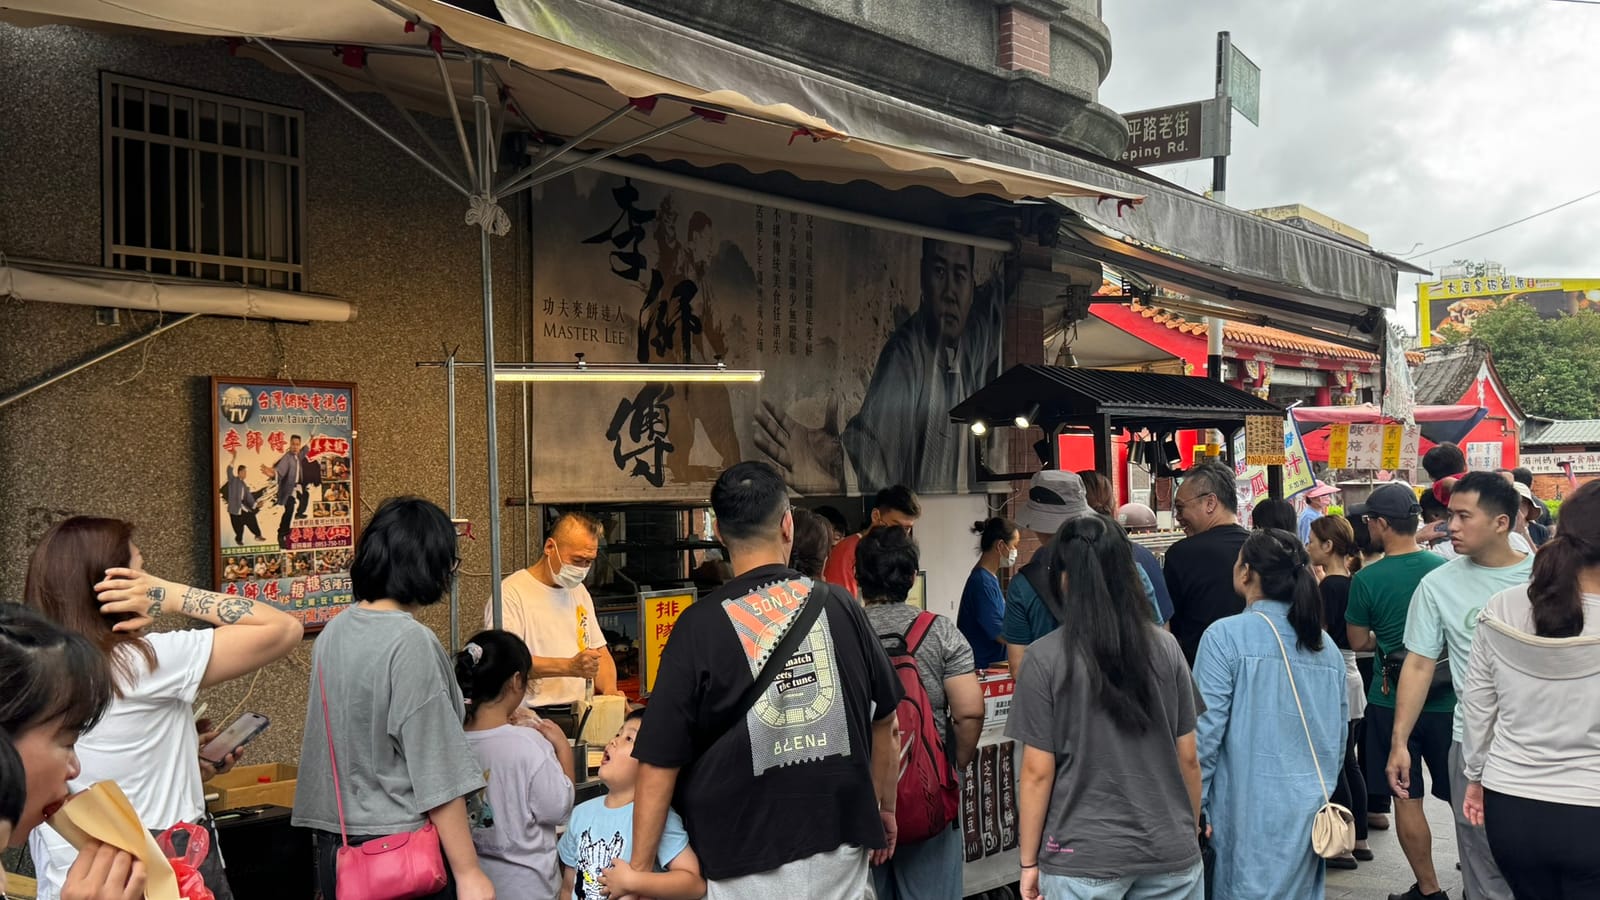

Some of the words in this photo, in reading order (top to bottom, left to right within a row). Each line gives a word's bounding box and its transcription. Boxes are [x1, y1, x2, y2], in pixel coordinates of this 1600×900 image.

[1128, 110, 1189, 144] 平路老街
[1114, 146, 1160, 161] eping
[1167, 140, 1188, 153] Rd.
[543, 297, 625, 323] 功夫麥餅達人
[544, 321, 600, 342] MASTER
[605, 327, 625, 344] LEE
[222, 396, 253, 407] TAIWAN
[257, 390, 348, 412] 台灣網路電視台
[229, 408, 248, 423] TV
[259, 413, 349, 426] www.taiwan-tv.tw
[223, 427, 288, 455] 李師傅
[774, 670, 793, 681] eets
[779, 681, 791, 692] the
[792, 675, 815, 687] tune.
